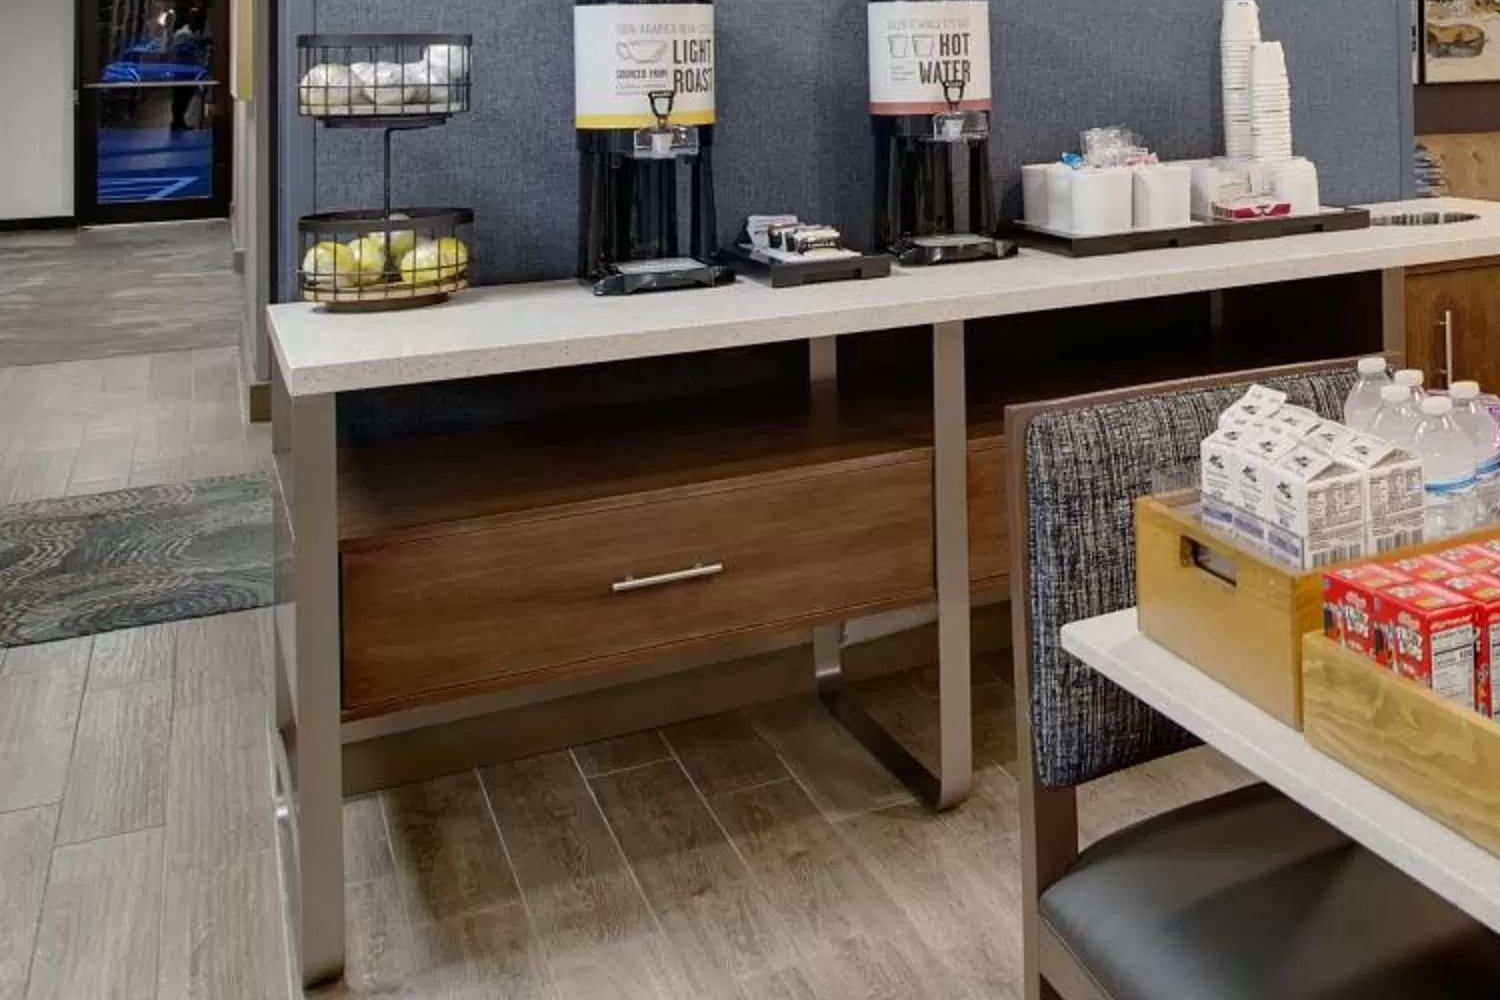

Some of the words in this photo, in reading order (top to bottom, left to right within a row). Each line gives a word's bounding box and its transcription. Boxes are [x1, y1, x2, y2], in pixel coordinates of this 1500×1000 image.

[672, 39, 712, 65] LIGHT
[939, 32, 971, 57] HOT
[672, 67, 713, 94] ROAST
[918, 59, 971, 85] WATER
